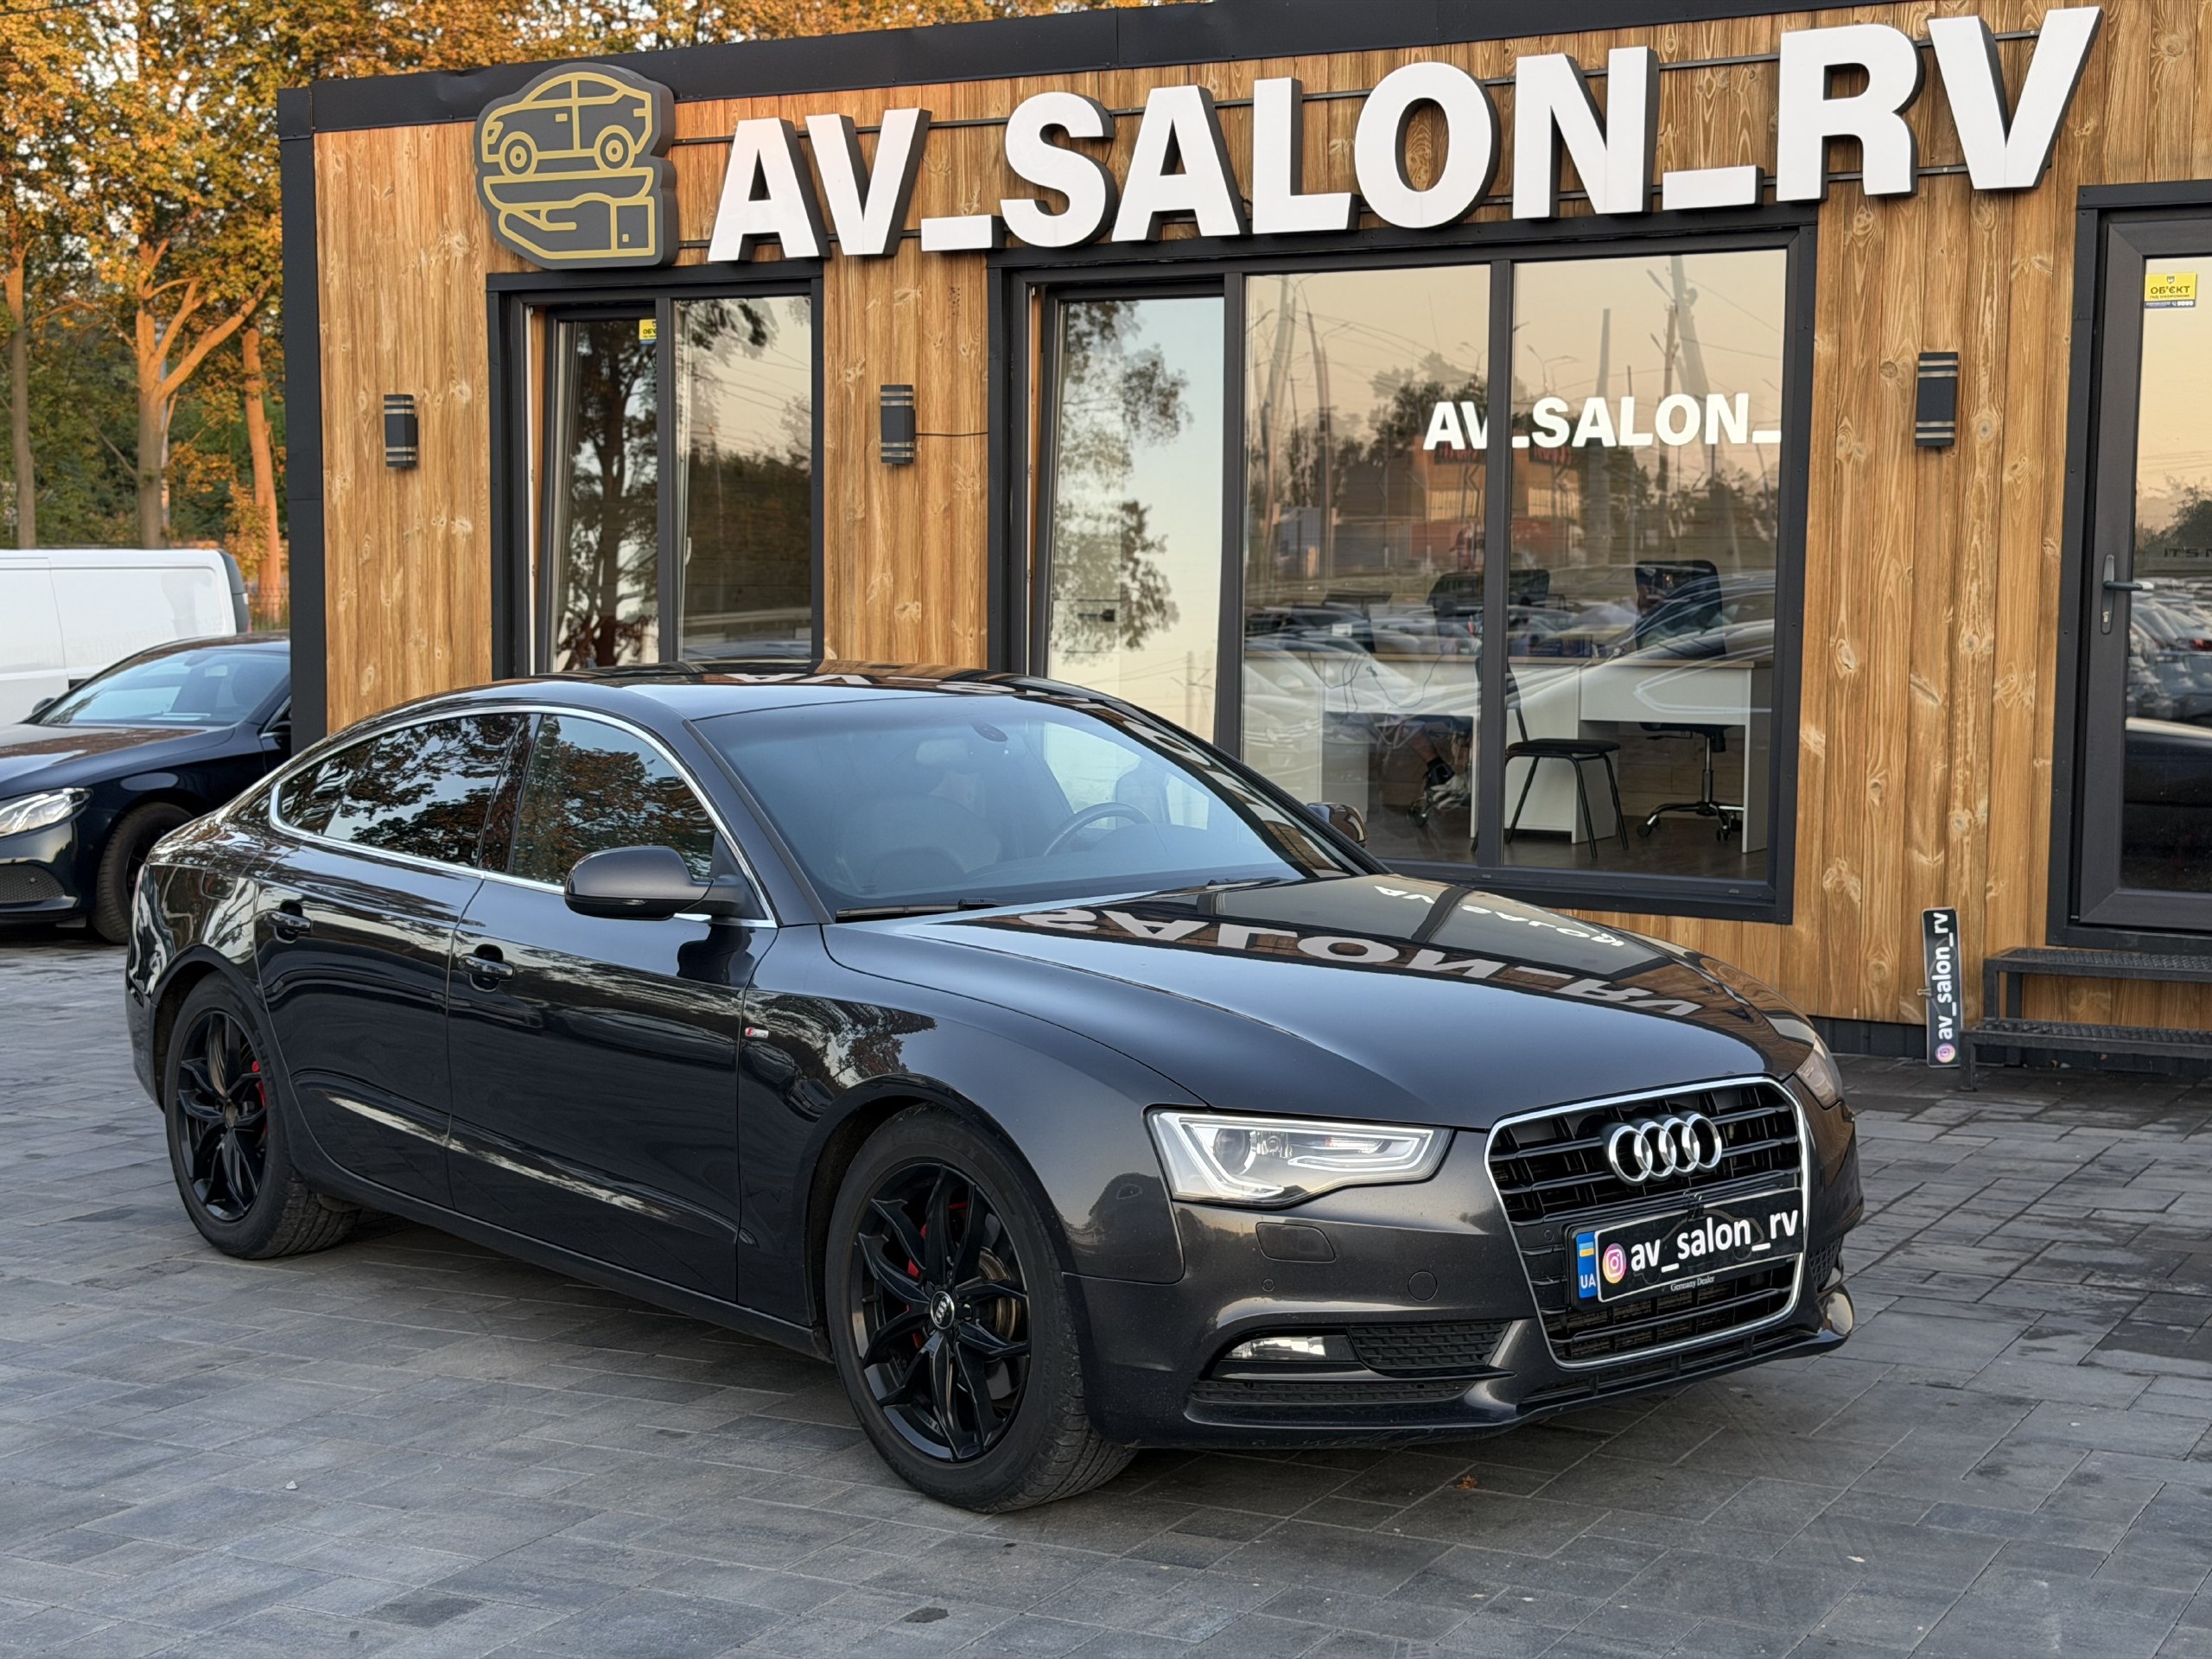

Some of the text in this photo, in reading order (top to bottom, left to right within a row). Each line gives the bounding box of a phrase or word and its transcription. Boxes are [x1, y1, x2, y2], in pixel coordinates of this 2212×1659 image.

[708, 6, 2104, 263] AV_SALON_RV
[1931, 912, 1957, 1040] av_salon_rv
[1580, 1273, 1597, 1289] UA
[1630, 1210, 1799, 1273] av_salon_rv
